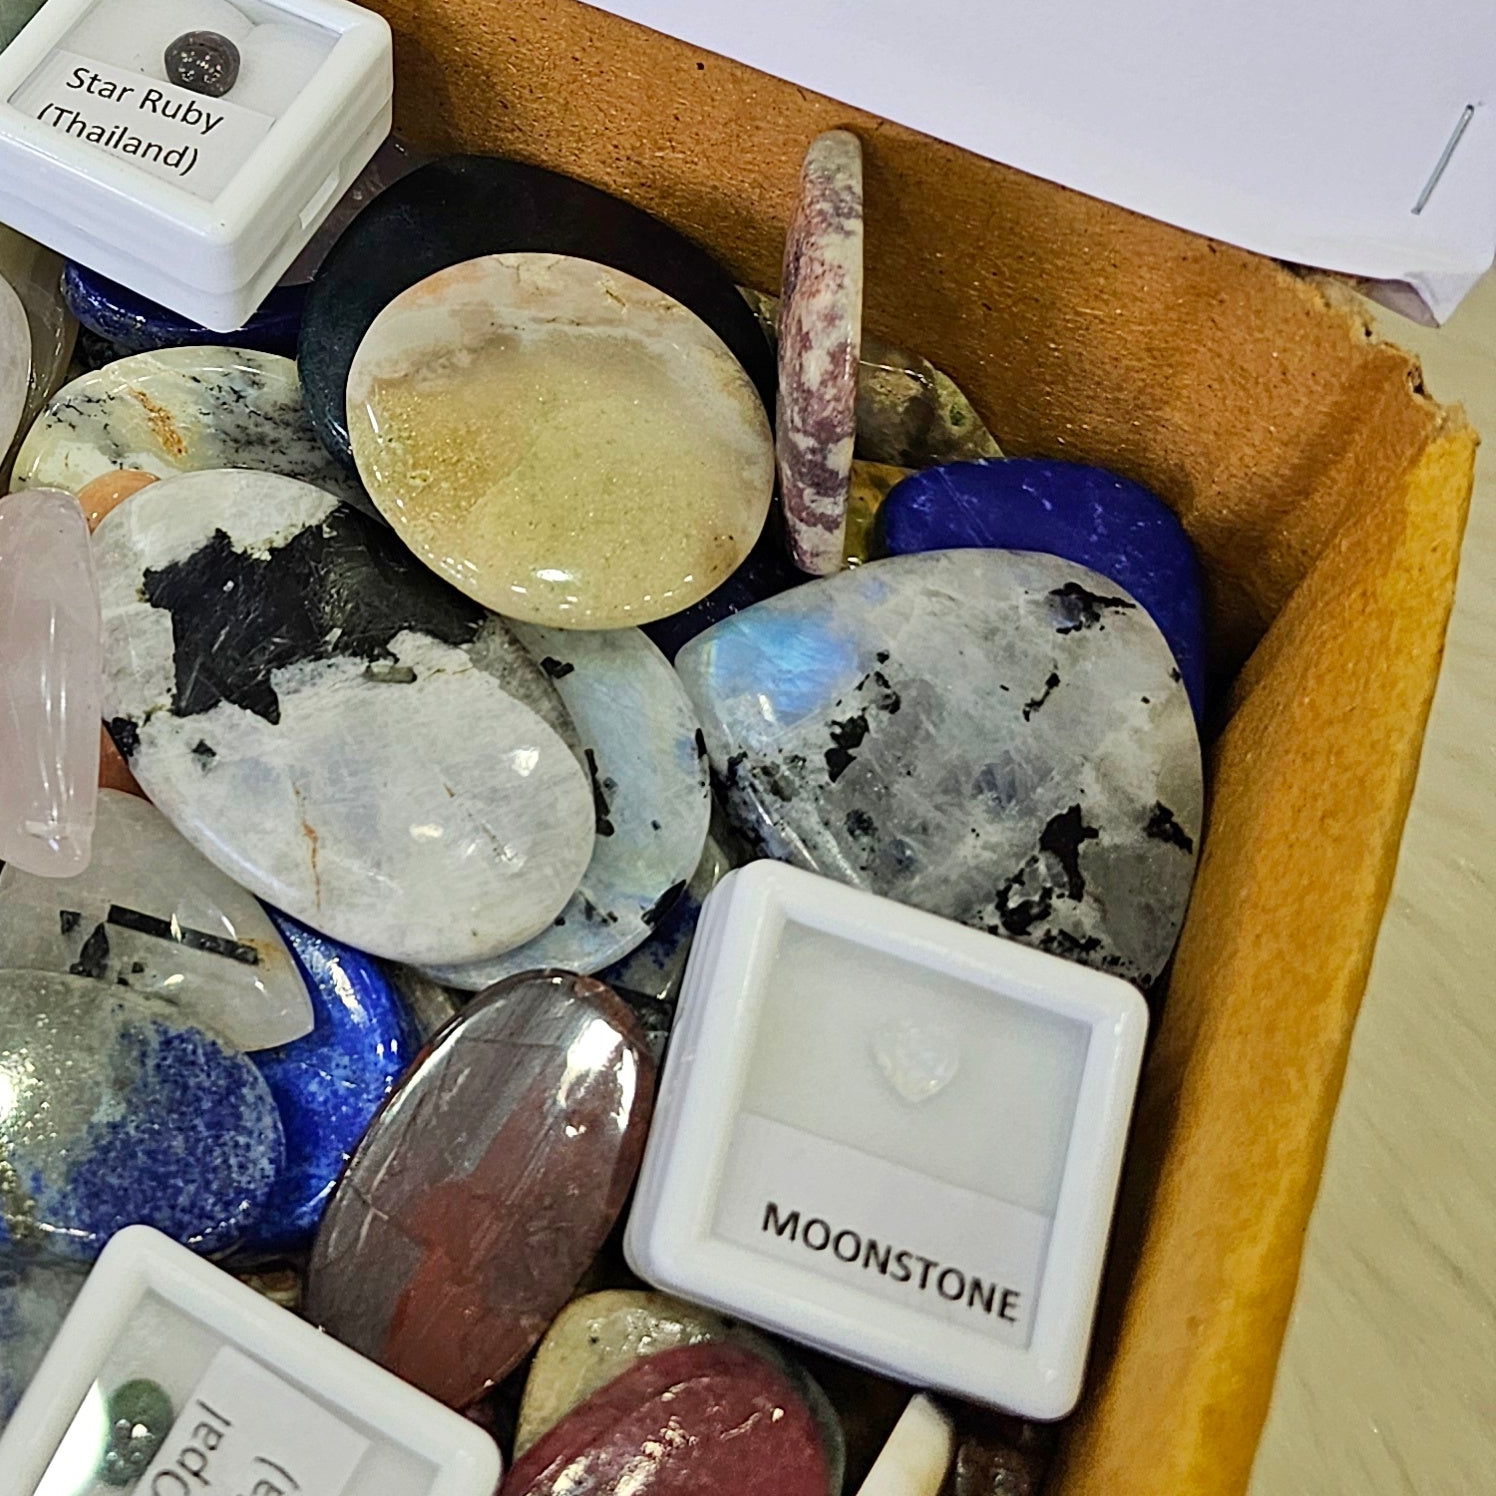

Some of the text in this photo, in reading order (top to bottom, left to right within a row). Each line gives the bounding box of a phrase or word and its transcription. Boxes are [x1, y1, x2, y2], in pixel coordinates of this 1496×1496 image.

[66, 67, 224, 135] Star Ruby
[36, 103, 199, 176] (Thailand)
[762, 1202, 1021, 1323] MOONSTONE
